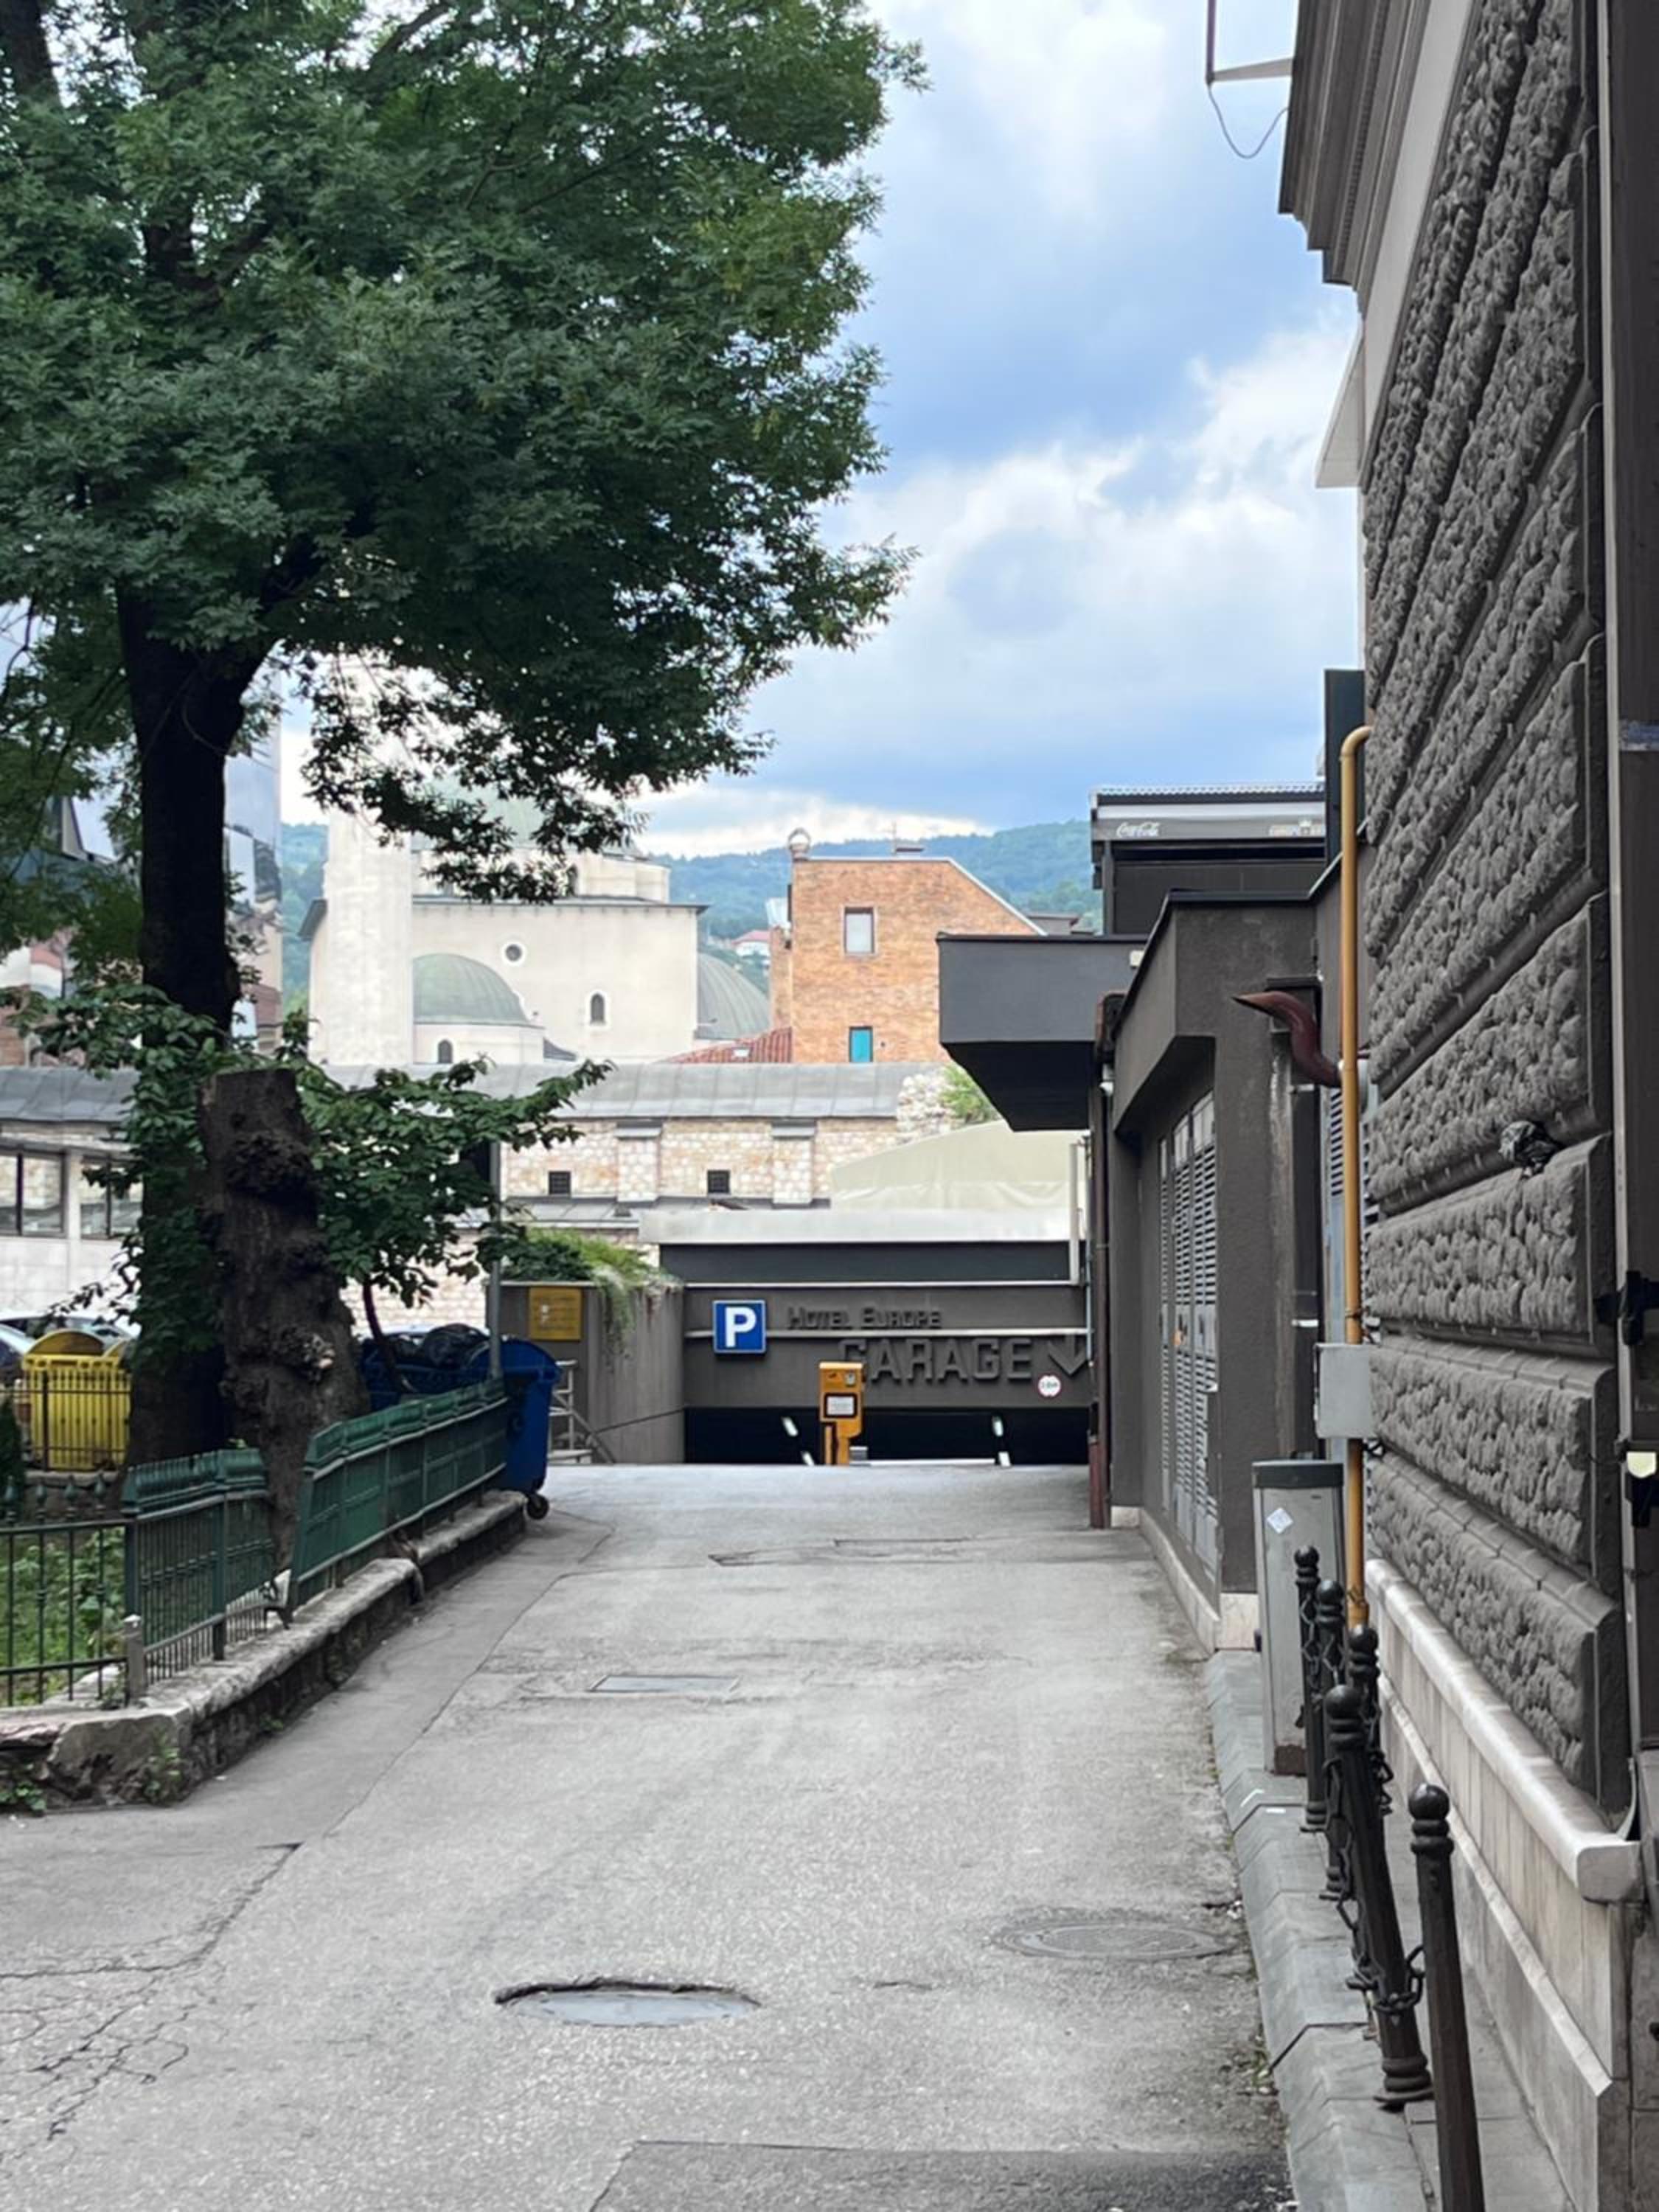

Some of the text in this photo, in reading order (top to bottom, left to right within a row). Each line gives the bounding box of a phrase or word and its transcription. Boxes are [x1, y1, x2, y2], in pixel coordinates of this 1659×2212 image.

[725, 1307, 757, 1348] P
[787, 1307, 942, 1329] HOTEL EUROPE
